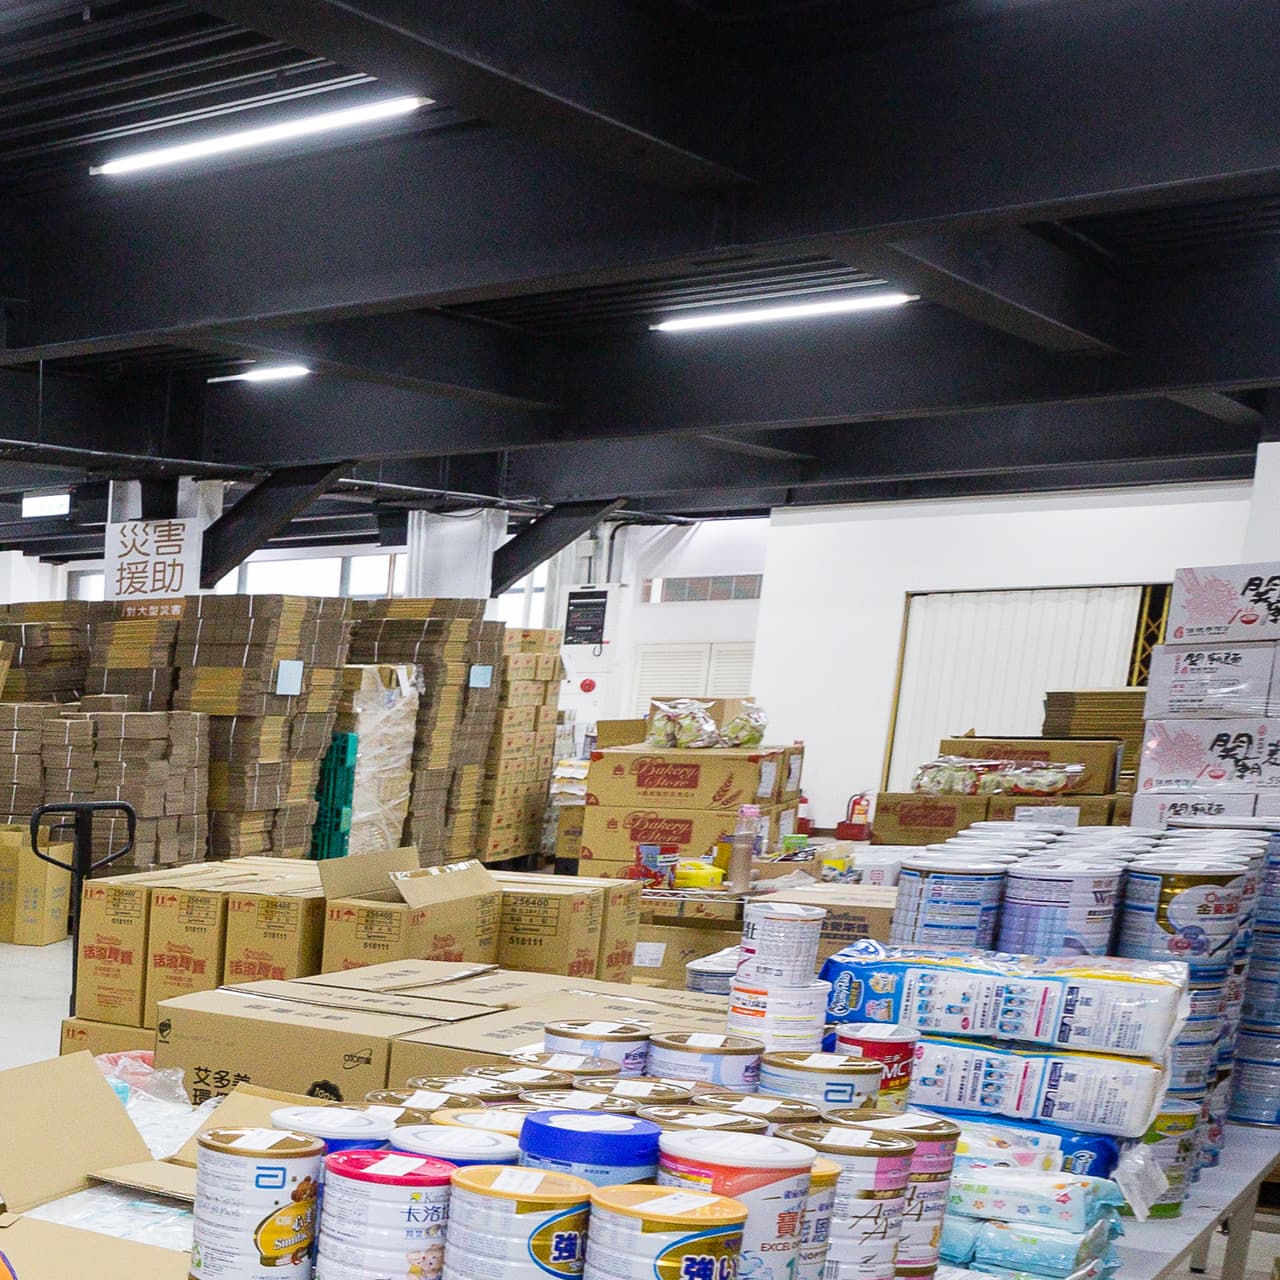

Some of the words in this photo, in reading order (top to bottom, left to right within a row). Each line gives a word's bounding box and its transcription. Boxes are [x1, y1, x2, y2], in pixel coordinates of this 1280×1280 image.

[118, 519, 186, 556] 災害
[115, 558, 185, 596] 援助
[629, 756, 698, 780] Bakery
[623, 811, 691, 835] Bakery
